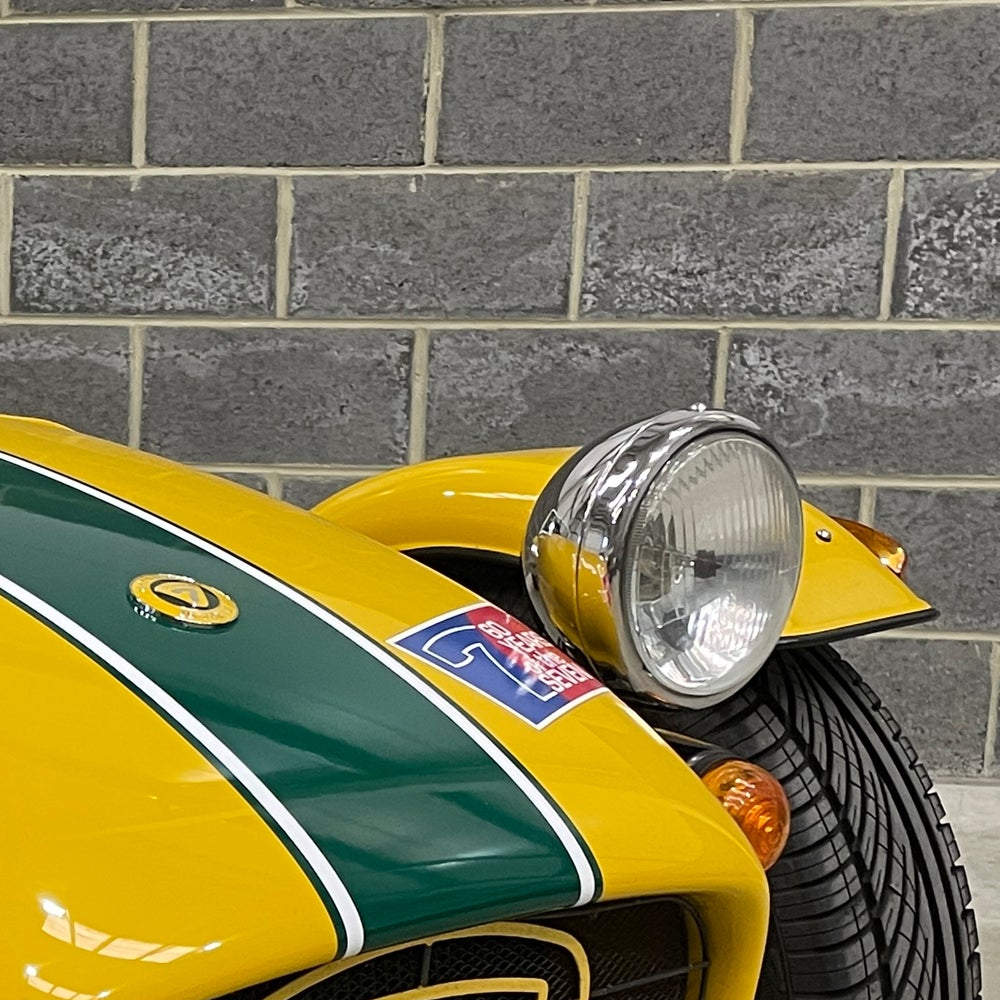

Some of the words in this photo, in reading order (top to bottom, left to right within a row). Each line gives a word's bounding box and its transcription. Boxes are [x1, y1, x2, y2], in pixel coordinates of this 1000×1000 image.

[477, 620, 511, 640] 60
[497, 630, 555, 660] YEARS
[421, 624, 559, 702] 7
[538, 662, 593, 693] SEVEN
